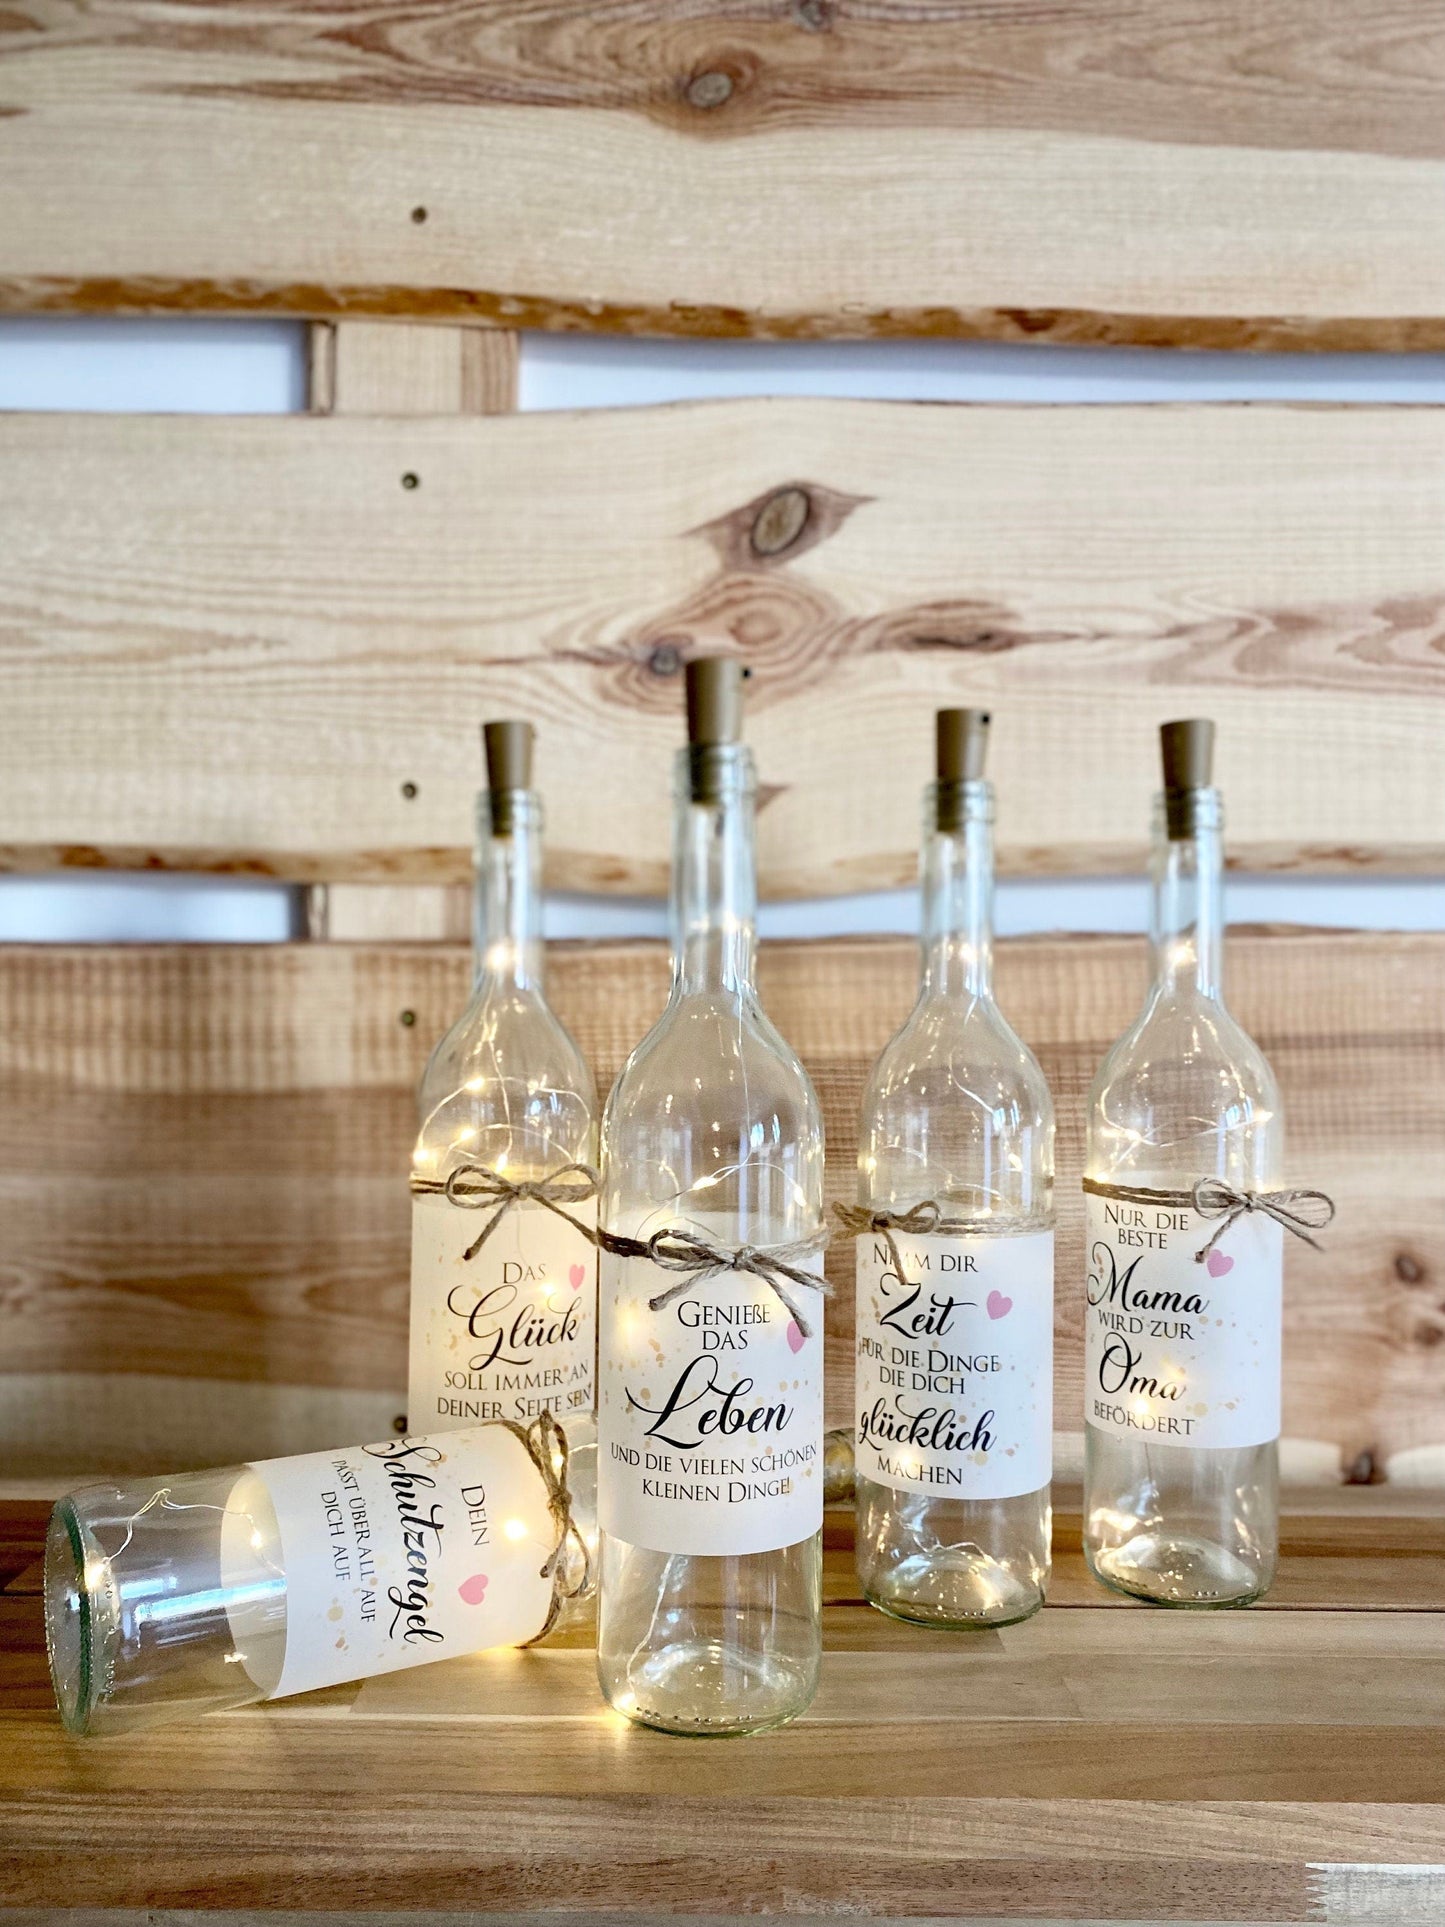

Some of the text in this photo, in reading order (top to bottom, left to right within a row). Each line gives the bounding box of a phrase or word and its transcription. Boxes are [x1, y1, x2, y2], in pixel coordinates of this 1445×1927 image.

[1104, 1203, 1189, 1231] NUR DIE
[1118, 1229, 1168, 1250] BESTE
[502, 1262, 547, 1284] DAS
[940, 1254, 979, 1273] DIR
[1087, 1241, 1210, 1315] Mama
[879, 1272, 979, 1340] Zeit
[447, 1284, 583, 1371] Glück
[701, 1329, 749, 1351] DAS
[1097, 1309, 1195, 1341] WIRD ZUR
[862, 1337, 1001, 1373] FÜR DIE DINGE
[1099, 1331, 1188, 1400] Oma
[444, 1360, 590, 1392] SOLL IMMER AN
[879, 1366, 966, 1395] DIE DICH
[437, 1396, 505, 1419] DEINER
[513, 1395, 563, 1420] SEITE
[624, 1354, 795, 1450] Leben
[1094, 1399, 1196, 1436] BEFÖRDERT
[859, 1394, 997, 1452] glücklich
[611, 1441, 818, 1476] UND DIE VIELEN SCHÖNEN
[877, 1455, 964, 1485] MACHEN
[642, 1476, 791, 1503] KLEINEN DINGE!
[461, 1484, 491, 1547] DEIN
[320, 1490, 352, 1581] DICH AUF
[331, 1460, 360, 1492] PASST
[360, 1588, 376, 1624] AUF
[361, 1436, 445, 1644] Schutzengel
